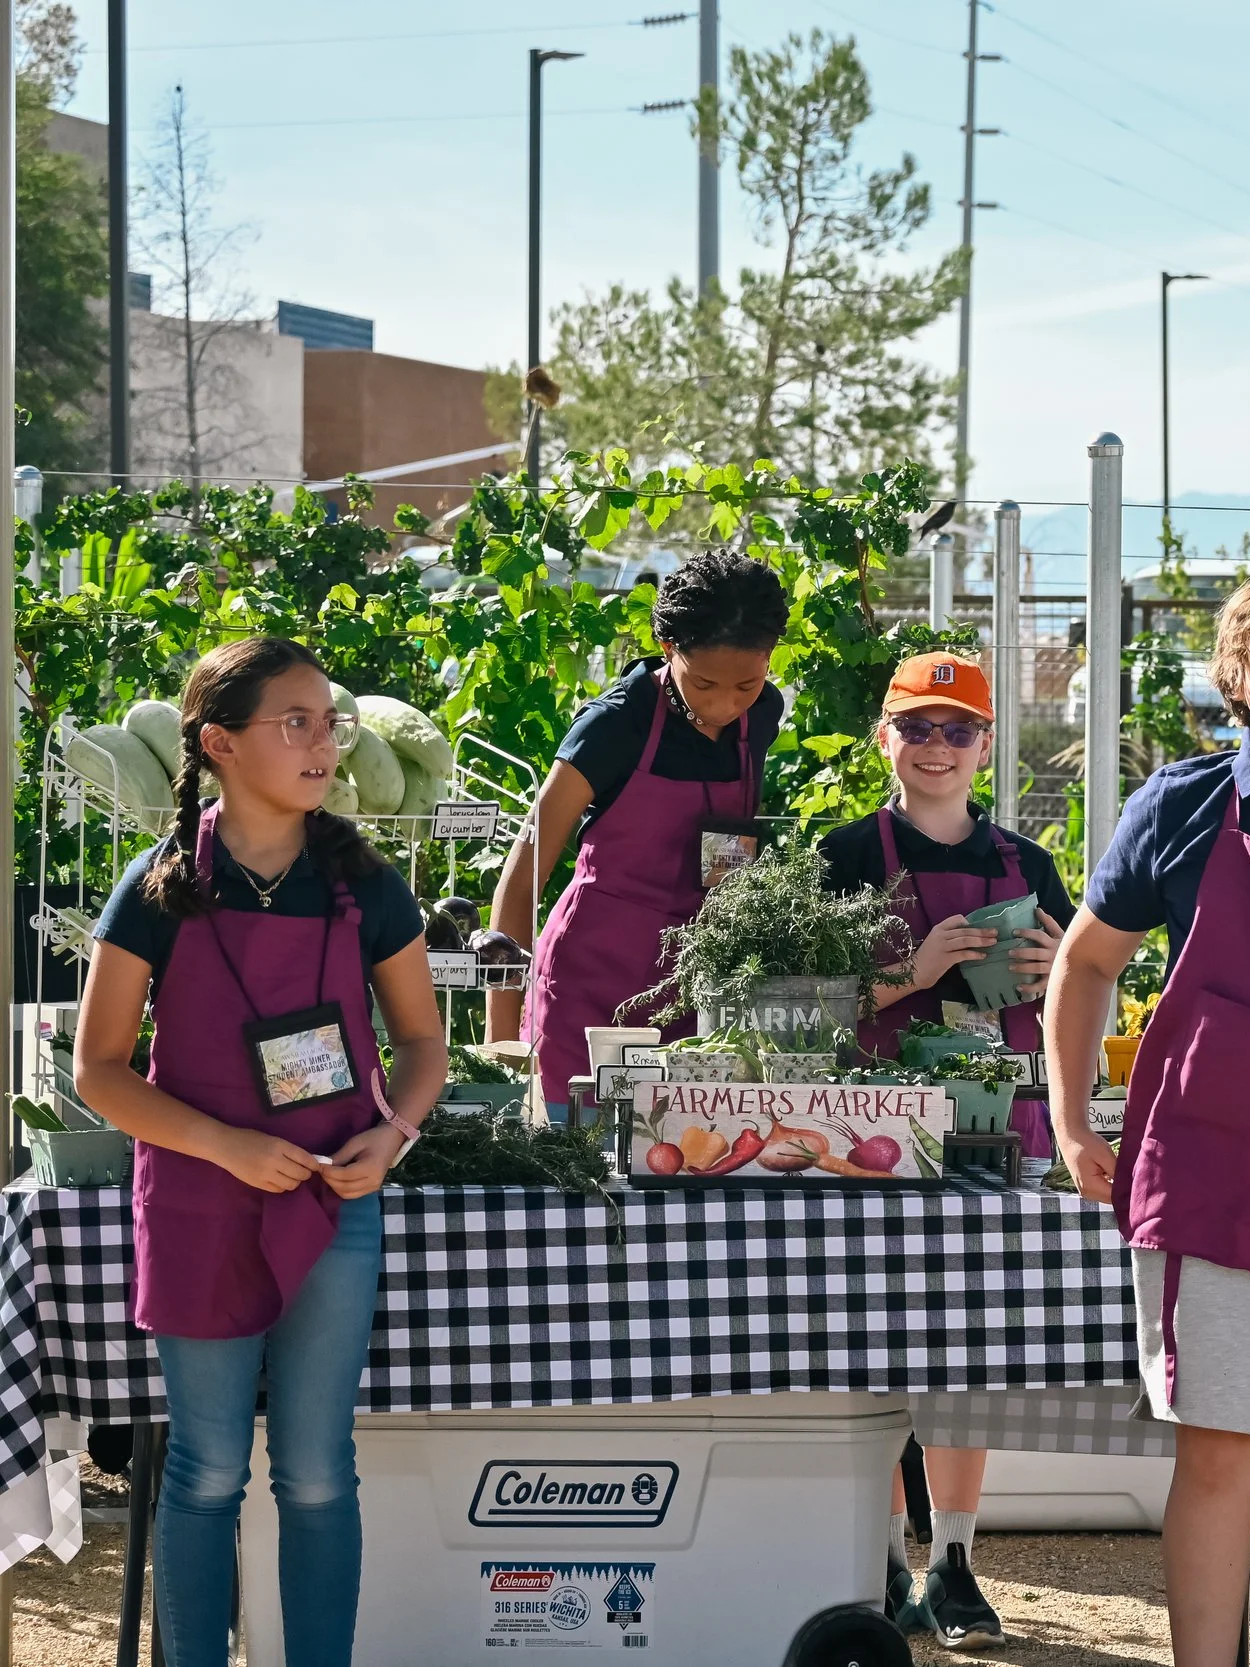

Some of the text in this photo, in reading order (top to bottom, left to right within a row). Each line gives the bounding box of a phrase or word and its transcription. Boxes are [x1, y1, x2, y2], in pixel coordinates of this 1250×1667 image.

[931, 663, 955, 686] D
[720, 1006, 821, 1032] FARM
[281, 1058, 307, 1072] MIGHTY
[309, 1053, 331, 1066] MINER
[301, 1059, 347, 1077] AMBASSADOR
[652, 1086, 933, 1123] FARMERS MARKET
[495, 1470, 626, 1506] Coleman
[496, 1574, 540, 1587] Coleman
[495, 1602, 546, 1613] 316 SERIES
[549, 1601, 586, 1620] WICHITA
[485, 1638, 496, 1647] 160
